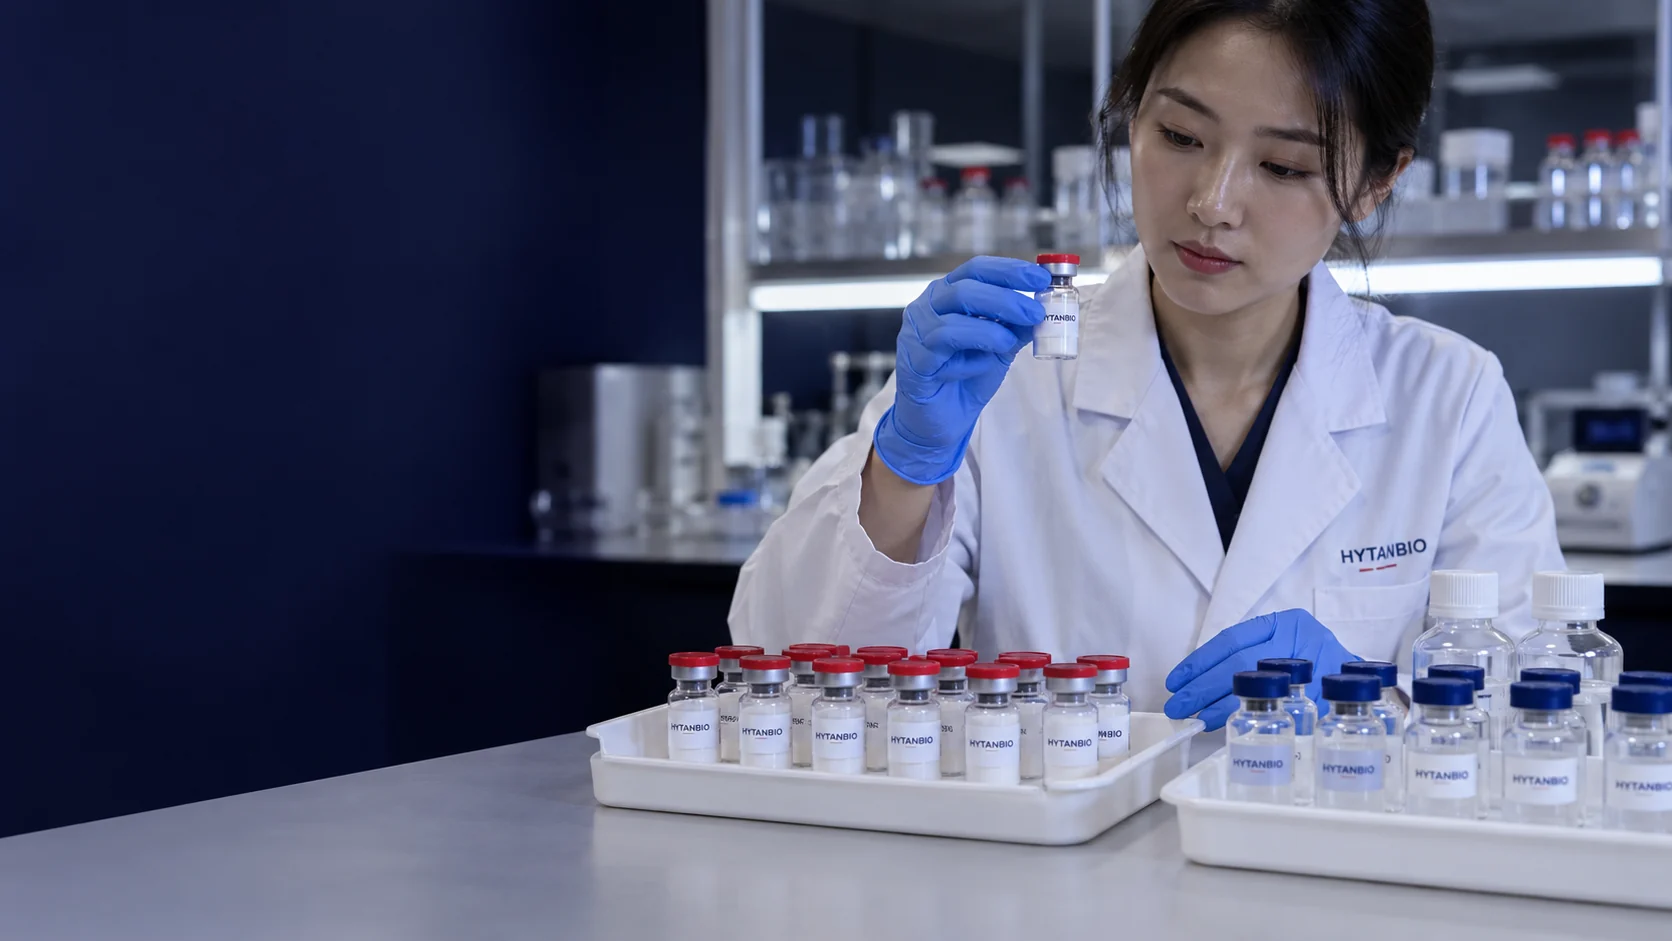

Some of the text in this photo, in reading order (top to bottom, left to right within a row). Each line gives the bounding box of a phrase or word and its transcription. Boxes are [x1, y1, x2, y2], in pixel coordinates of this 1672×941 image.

[1341, 538, 1427, 564] HYTANBIO
[671, 723, 710, 732] HYTANBIO
[742, 727, 783, 736] HYTANBIO
[815, 732, 858, 741] HYTANBIO
[890, 736, 933, 745] HYTANBIO
[969, 739, 1014, 749] HYTANBIO
[1047, 738, 1092, 748] HYTANBIO
[1233, 758, 1283, 769] HYTANBIO
[1322, 763, 1375, 775] HYTANBIO
[1415, 769, 1469, 780] HYTANBIO
[1512, 774, 1569, 786] HYTANBIO
[1615, 779, 1672, 792] HYTANBIO
